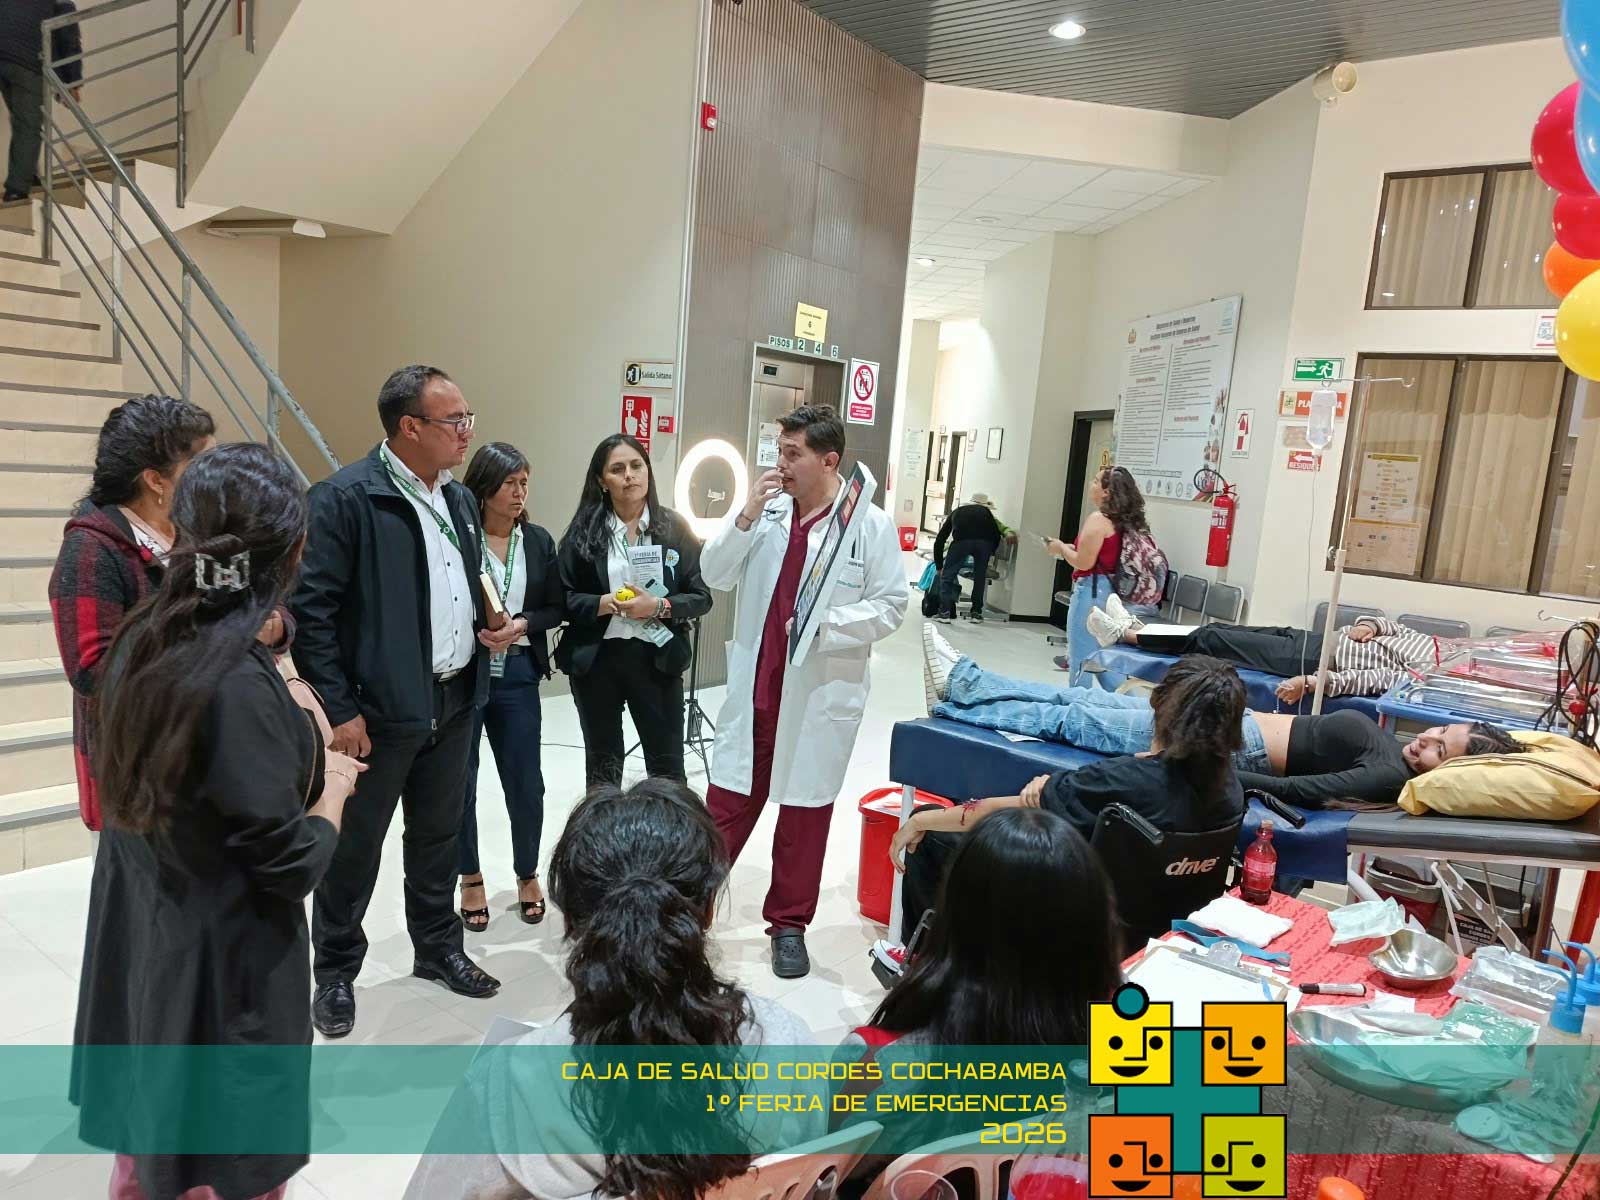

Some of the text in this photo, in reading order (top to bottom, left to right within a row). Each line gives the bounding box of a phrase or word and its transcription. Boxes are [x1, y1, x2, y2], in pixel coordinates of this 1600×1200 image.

[770, 336, 838, 357] PISOS 2 4 6
[1165, 857, 1217, 876] drive
